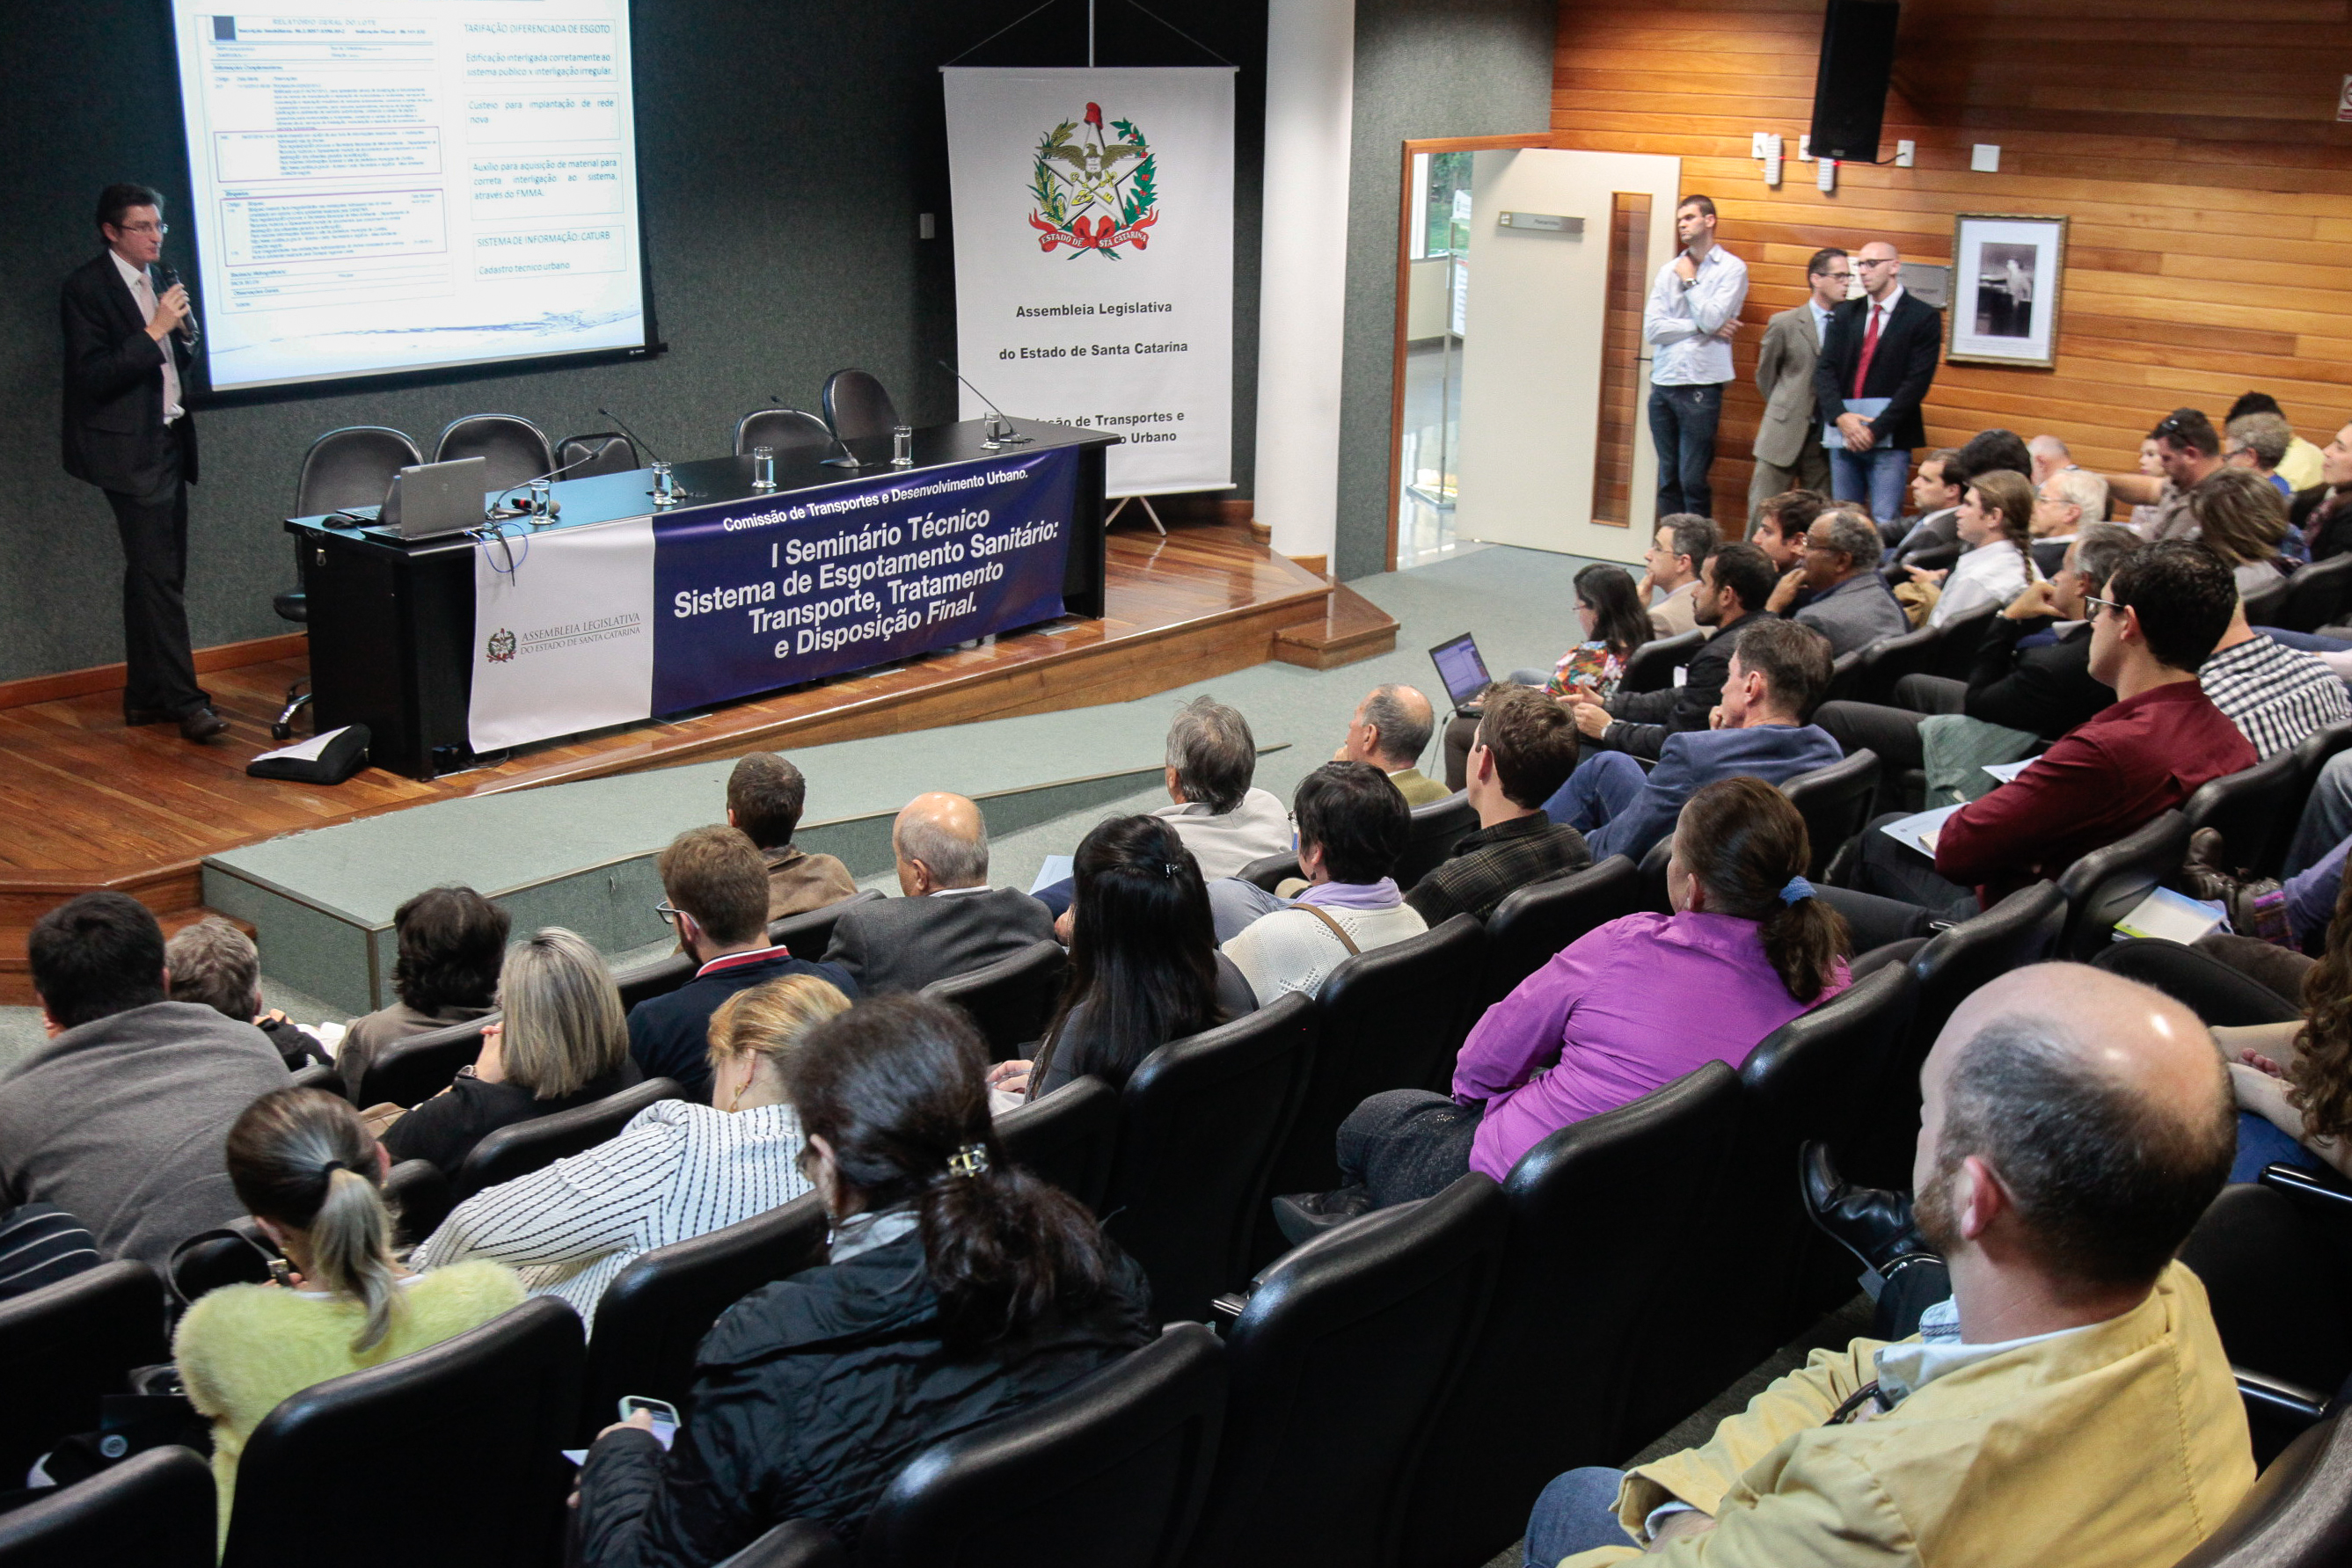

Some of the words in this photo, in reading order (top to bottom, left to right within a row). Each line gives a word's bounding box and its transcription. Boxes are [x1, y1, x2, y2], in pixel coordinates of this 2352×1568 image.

[568, 25, 578, 33] DE
[580, 25, 610, 33] ESGOTO
[505, 102, 522, 111] para
[500, 164, 518, 172] para
[520, 160, 555, 171] aquisição
[557, 160, 566, 169] de
[568, 159, 598, 168] material
[600, 159, 617, 169] para
[474, 177, 501, 186] correta
[478, 237, 511, 246] SISTEMA
[513, 237, 522, 245] DE
[581, 231, 610, 241] CATURB
[1041, 233, 1071, 244] ESTADO
[1072, 237, 1085, 246] DE
[1114, 231, 1147, 244] CATARINA
[479, 266, 513, 275] Cadastro
[543, 262, 570, 271] urbano
[1016, 304, 1094, 317] Assembleia
[1099, 302, 1172, 317] Legislativa
[999, 348, 1016, 361] do
[1020, 346, 1066, 359] Estado
[1070, 345, 1087, 357] de
[1091, 344, 1130, 356] Santa
[1134, 341, 1188, 354] Catarina
[1076, 415, 1091, 427] de
[1095, 412, 1172, 427] Transportes
[1177, 412, 1185, 420] e
[1131, 432, 1177, 444] Urbano
[723, 509, 787, 532] Comissão
[789, 505, 806, 521] de
[807, 492, 879, 517] Transportes
[882, 492, 890, 504] e
[892, 476, 985, 502] Desenvolvimento
[986, 469, 1028, 485] Urbano.
[771, 543, 778, 568] I
[785, 523, 902, 565] Seminário
[908, 509, 990, 543] Técnico
[674, 580, 775, 618] Sistema
[783, 570, 812, 596] de
[820, 541, 965, 590] Esgotamento
[970, 516, 1059, 558] Sanitário:
[749, 590, 881, 634] Transporte,
[887, 560, 1004, 604] Tratamento
[522, 624, 581, 642] ASSEMBLEIA
[583, 613, 640, 631] LEGISLATIVA
[775, 639, 789, 659] e
[797, 609, 922, 655] Disposição
[927, 592, 977, 624] Final.
[520, 645, 534, 655] DO
[536, 640, 566, 653] ESTADO
[567, 638, 577, 647] DE
[579, 634, 603, 645] SANTA
[604, 626, 640, 640] CATARINA
